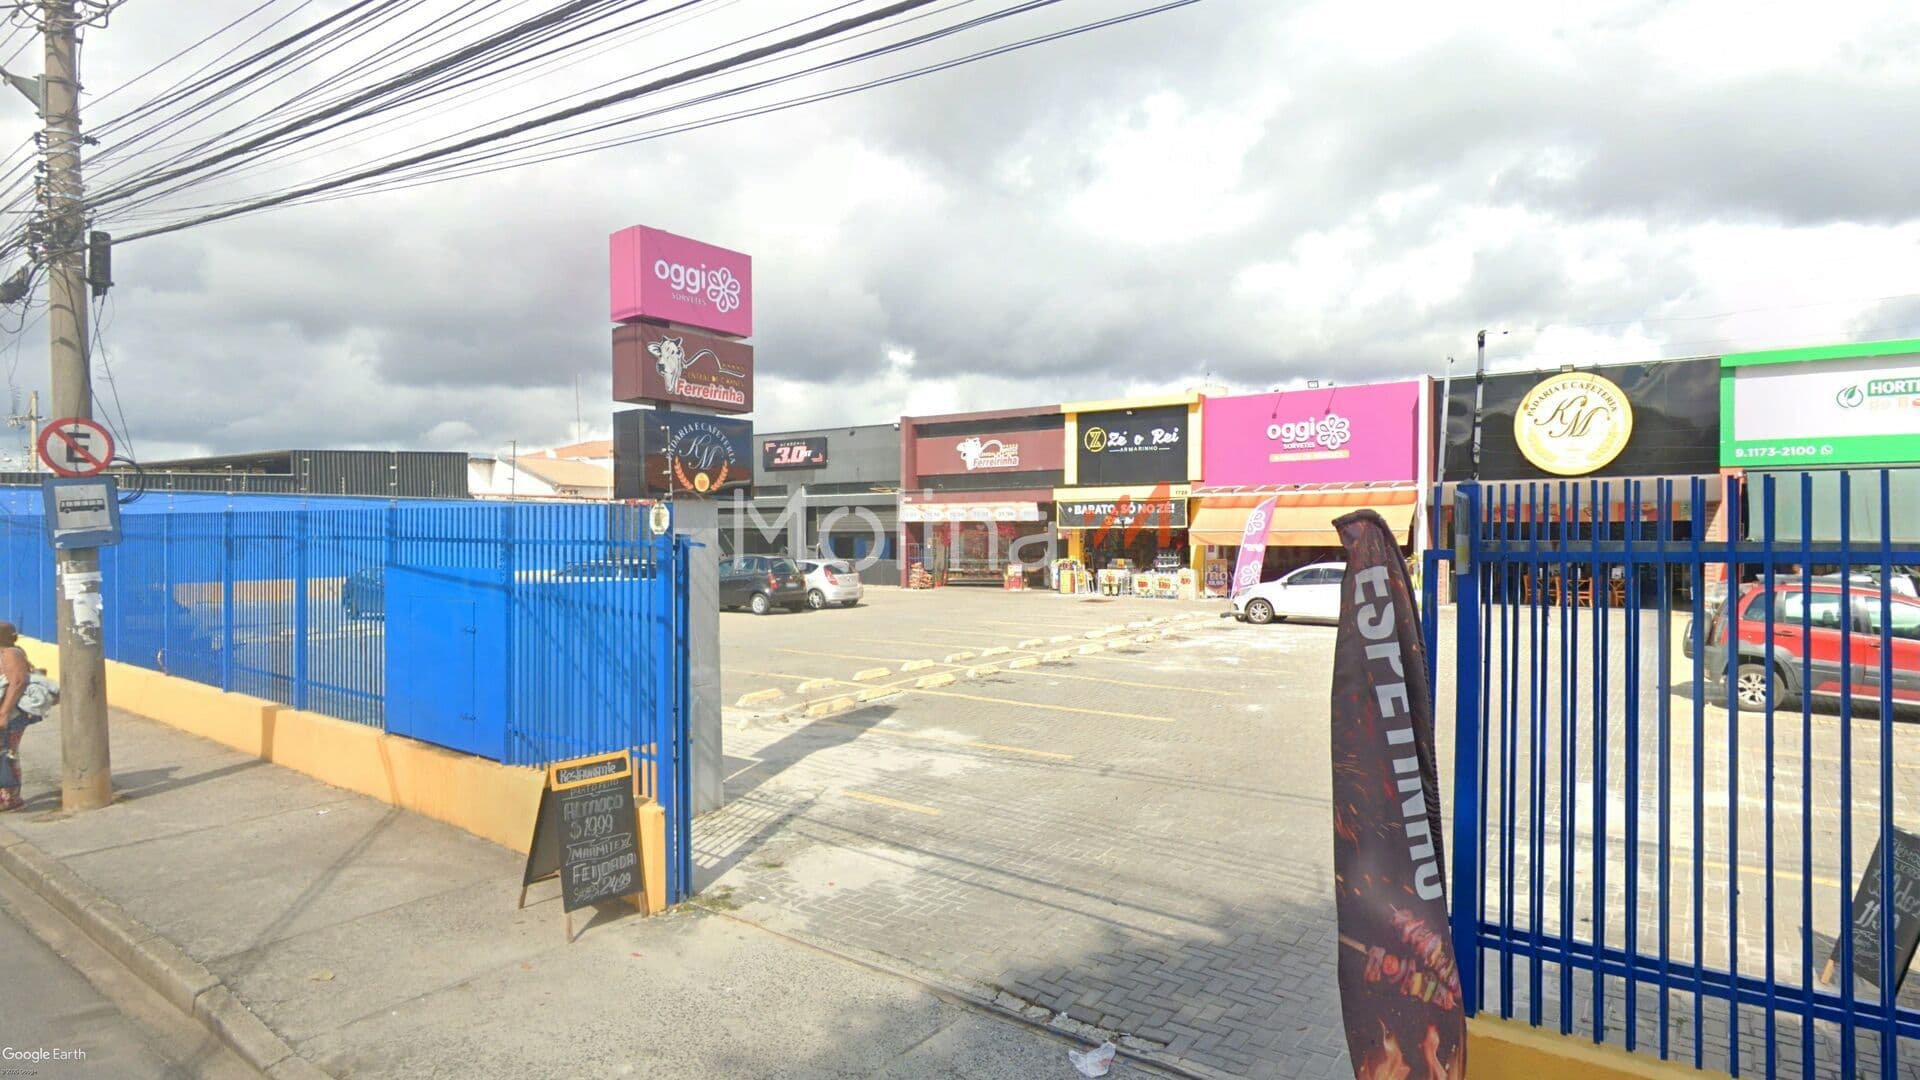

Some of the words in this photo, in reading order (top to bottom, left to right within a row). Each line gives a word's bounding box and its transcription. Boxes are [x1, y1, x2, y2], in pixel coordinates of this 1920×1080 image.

[655, 259, 706, 294] oggi
[675, 379, 744, 404] Ferreirinha
[1527, 386, 1561, 417] PADARIA
[1571, 382, 1618, 413] CAFETERIA
[1107, 430, 1127, 447] Zé
[1134, 434, 1144, 445] o
[1151, 427, 1179, 445] Rei
[1267, 417, 1315, 443] oggi
[66, 432, 90, 463] E
[700, 422, 736, 465] CAFETERIA
[774, 445, 807, 464] 3.0
[1735, 446, 1816, 458] 9.1173-2100
[1138, 504, 1155, 514] NO
